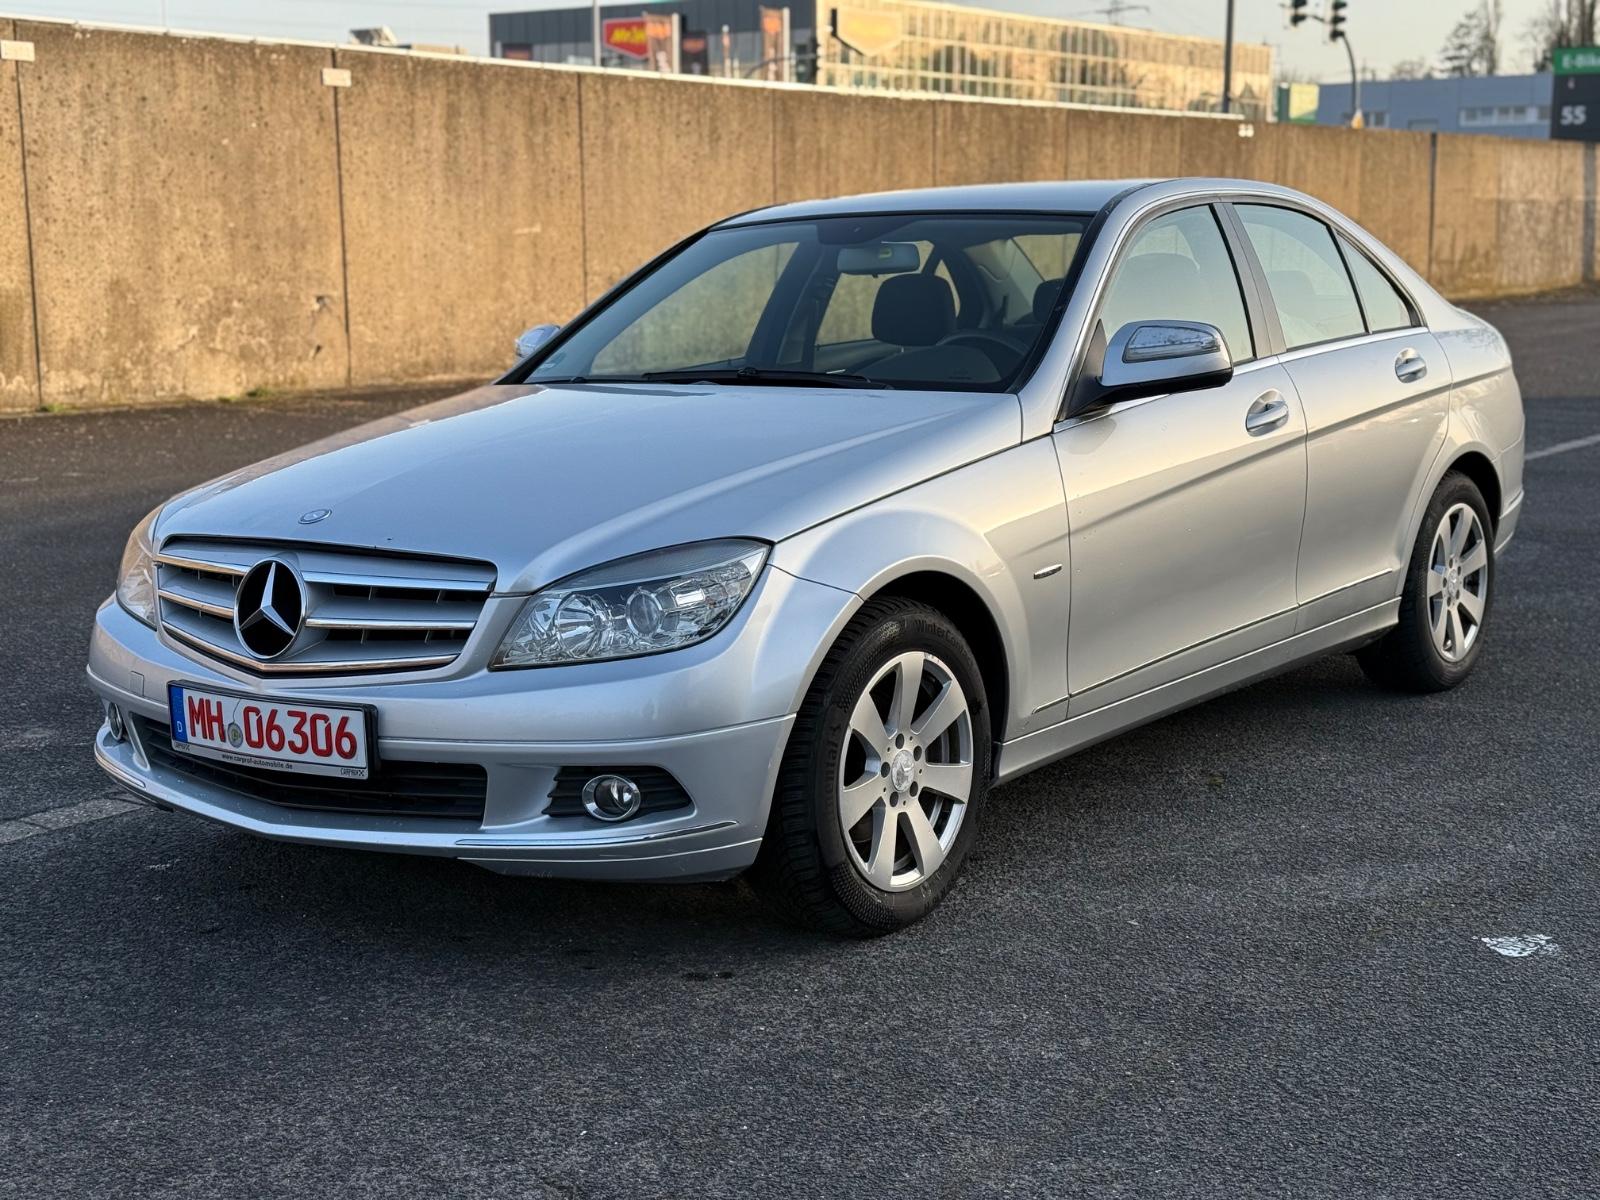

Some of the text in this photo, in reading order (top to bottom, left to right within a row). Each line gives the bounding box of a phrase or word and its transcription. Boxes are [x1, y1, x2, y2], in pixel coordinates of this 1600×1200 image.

[177, 720, 183, 733] D
[187, 695, 358, 760] MH 06306
